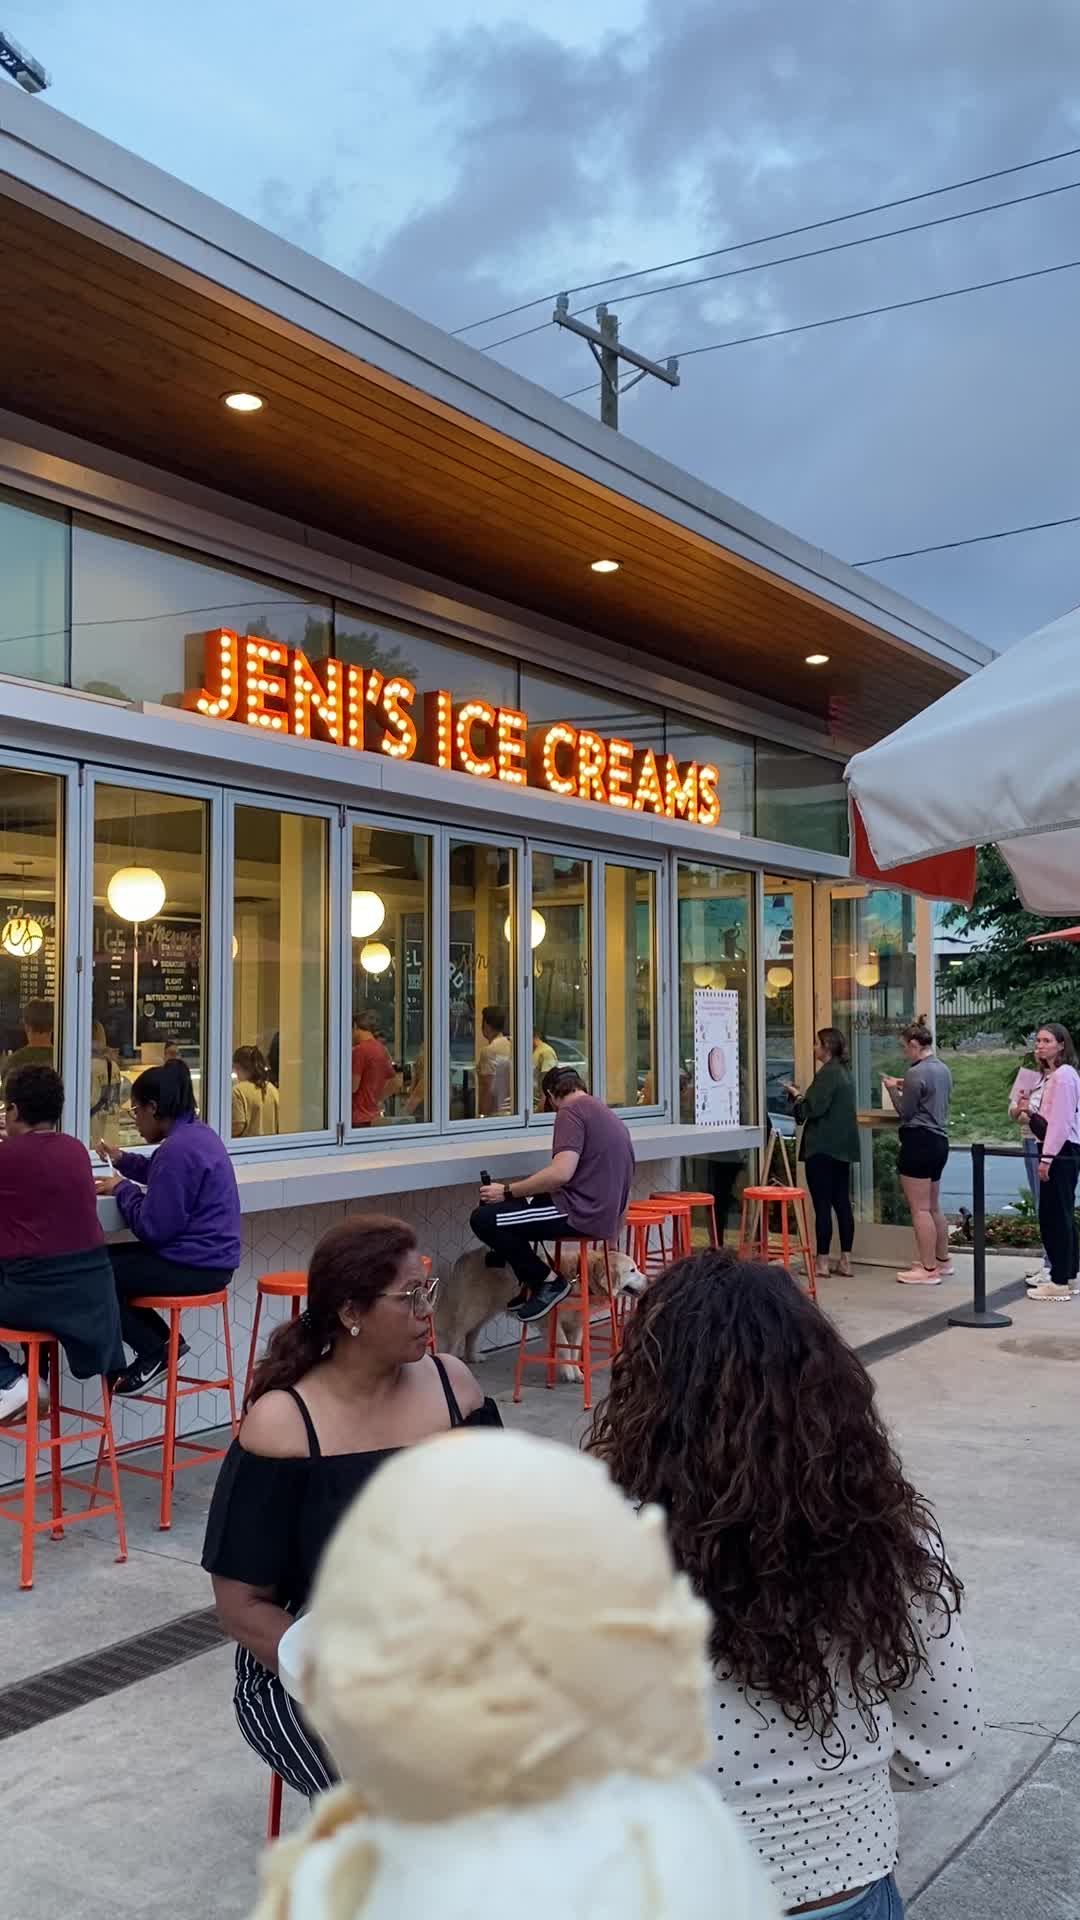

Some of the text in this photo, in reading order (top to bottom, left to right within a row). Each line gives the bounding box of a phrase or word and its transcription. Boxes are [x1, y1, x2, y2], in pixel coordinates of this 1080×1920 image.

[185, 628, 720, 827] JENI'S ICE CREAMS
